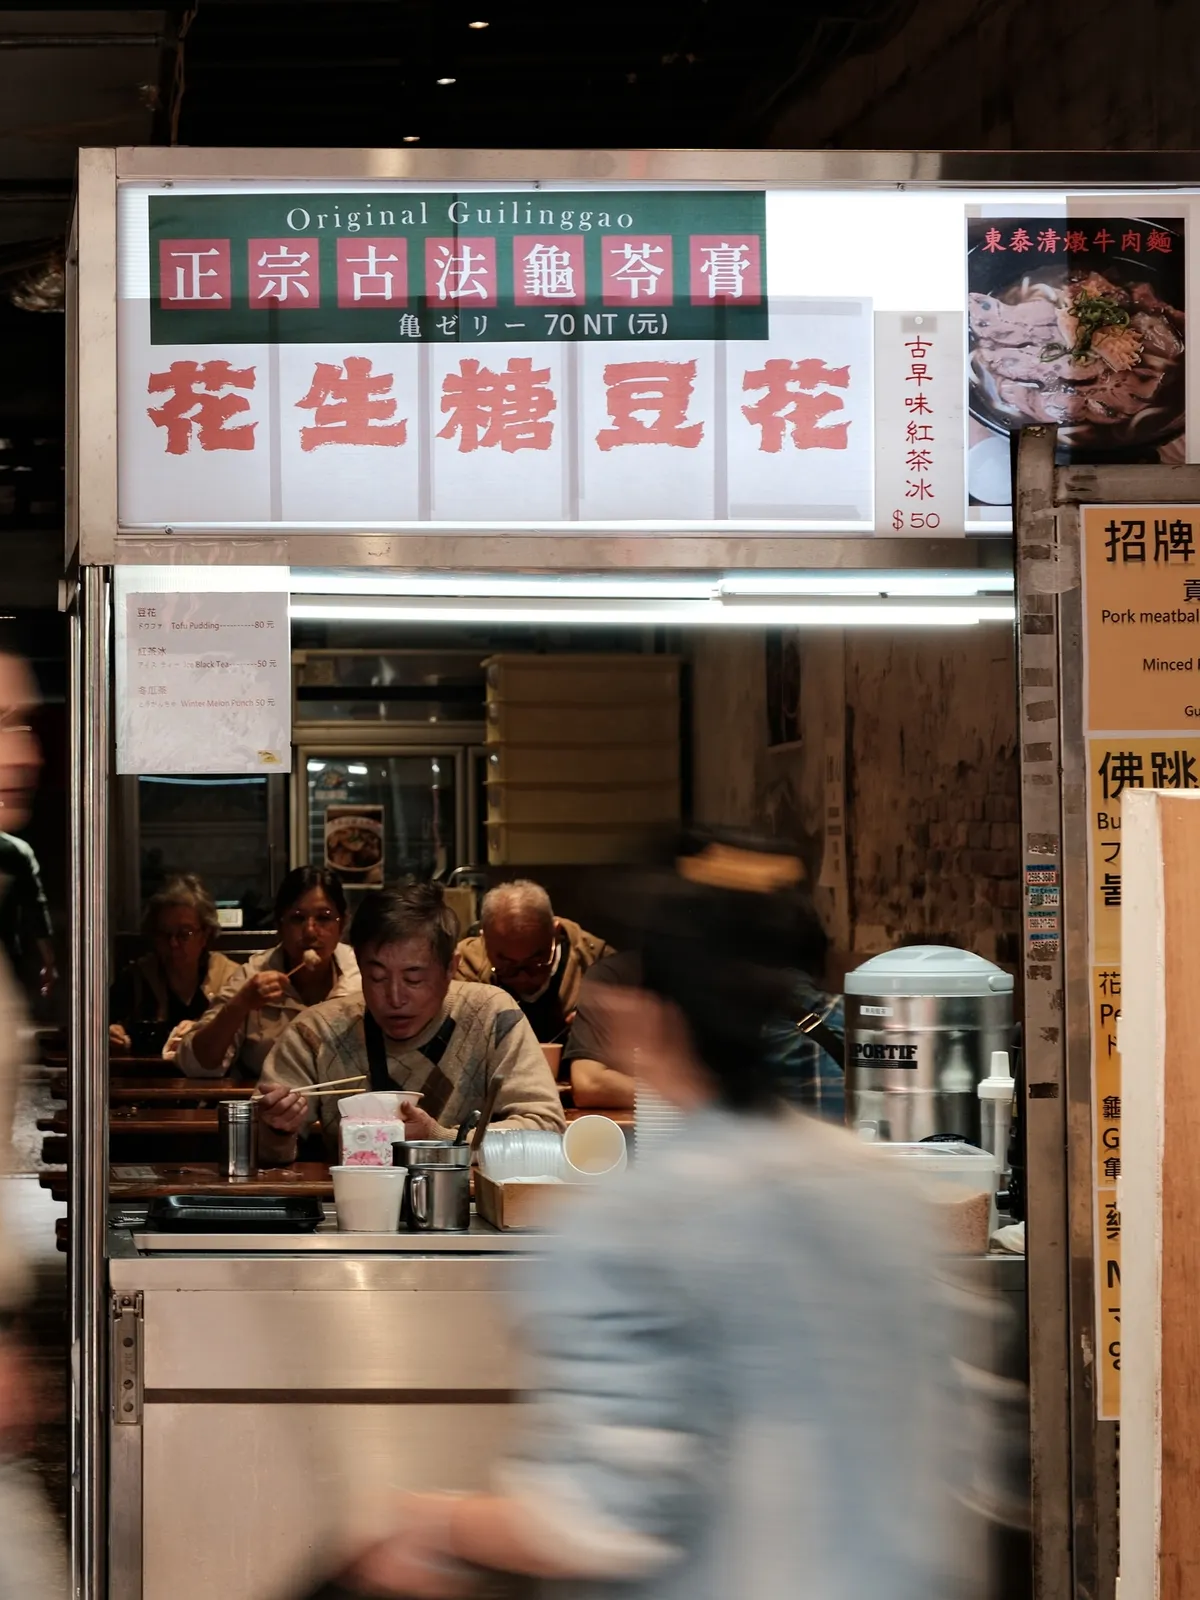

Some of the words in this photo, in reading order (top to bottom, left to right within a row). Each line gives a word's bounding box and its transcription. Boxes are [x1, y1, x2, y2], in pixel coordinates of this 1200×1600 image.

[286, 201, 428, 231] Original
[448, 200, 633, 231] Guilinggao
[981, 227, 1173, 254] 東泰清燉牛肉麵
[168, 241, 751, 303] 正宗古法龜苓膏
[544, 314, 575, 335] 70
[584, 314, 618, 335] NT
[628, 313, 668, 336] (元)
[146, 356, 853, 455] 花生糖豆花
[904, 335, 935, 501] 古早味紅茶冰
[1104, 519, 1196, 562] 招牌
[137, 608, 156, 618] 豆花
[1101, 608, 1136, 623] Pork
[171, 622, 188, 630] Tofu
[190, 621, 219, 632] Pudding
[195, 660, 215, 669] Black
[216, 660, 229, 669] Tea
[1143, 657, 1193, 671] Minced
[180, 699, 205, 708] Winter
[206, 699, 230, 707] Melon
